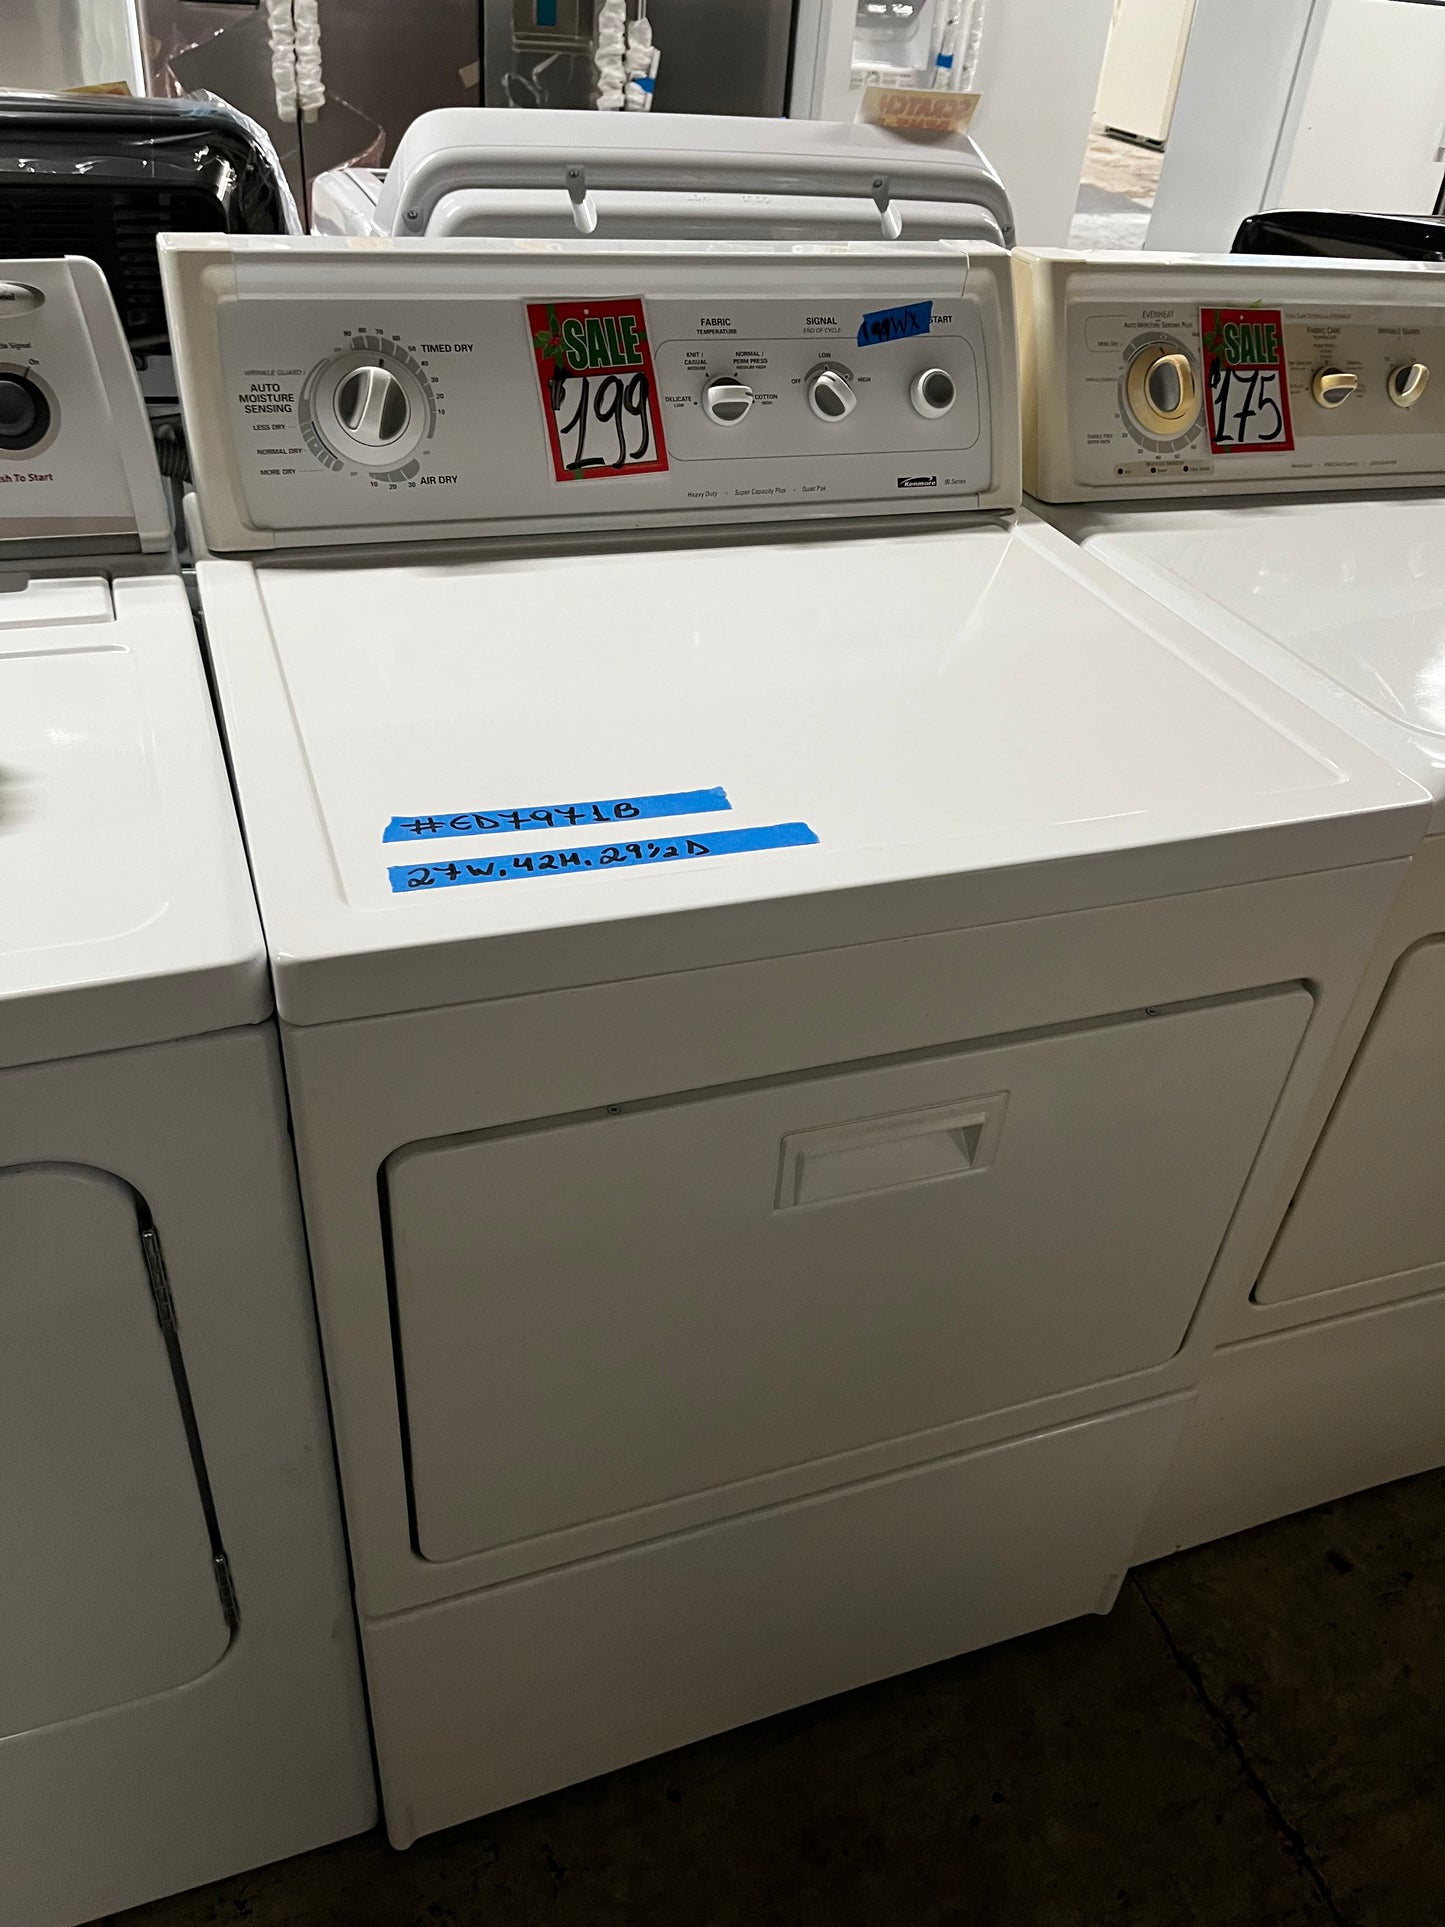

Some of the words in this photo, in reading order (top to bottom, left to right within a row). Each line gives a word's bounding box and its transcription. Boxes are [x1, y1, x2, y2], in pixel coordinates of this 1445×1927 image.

[700, 318, 731, 326] FABRIC
[806, 317, 837, 326] SIGNAL
[928, 315, 953, 324] START
[561, 314, 644, 371] SALE
[1223, 321, 1280, 366] SALE
[420, 344, 452, 353] TIMED
[454, 344, 474, 353] DRY
[28, 358, 40, 366] On
[250, 383, 281, 393] AUTO
[238, 393, 295, 403] MOISTURE
[1209, 357, 1283, 443] $175
[244, 403, 292, 414] SENSING
[257, 448, 288, 456] NORMAL
[288, 447, 303, 455] DRY
[259, 468, 281, 476] MORE
[13, 473, 27, 482] To
[28, 473, 54, 482] Start
[420, 476, 437, 485] AIR
[438, 475, 458, 484] DRY
[903, 479, 937, 488] Kenmore
[705, 490, 718, 498] Duty
[751, 488, 775, 496] Capacity
